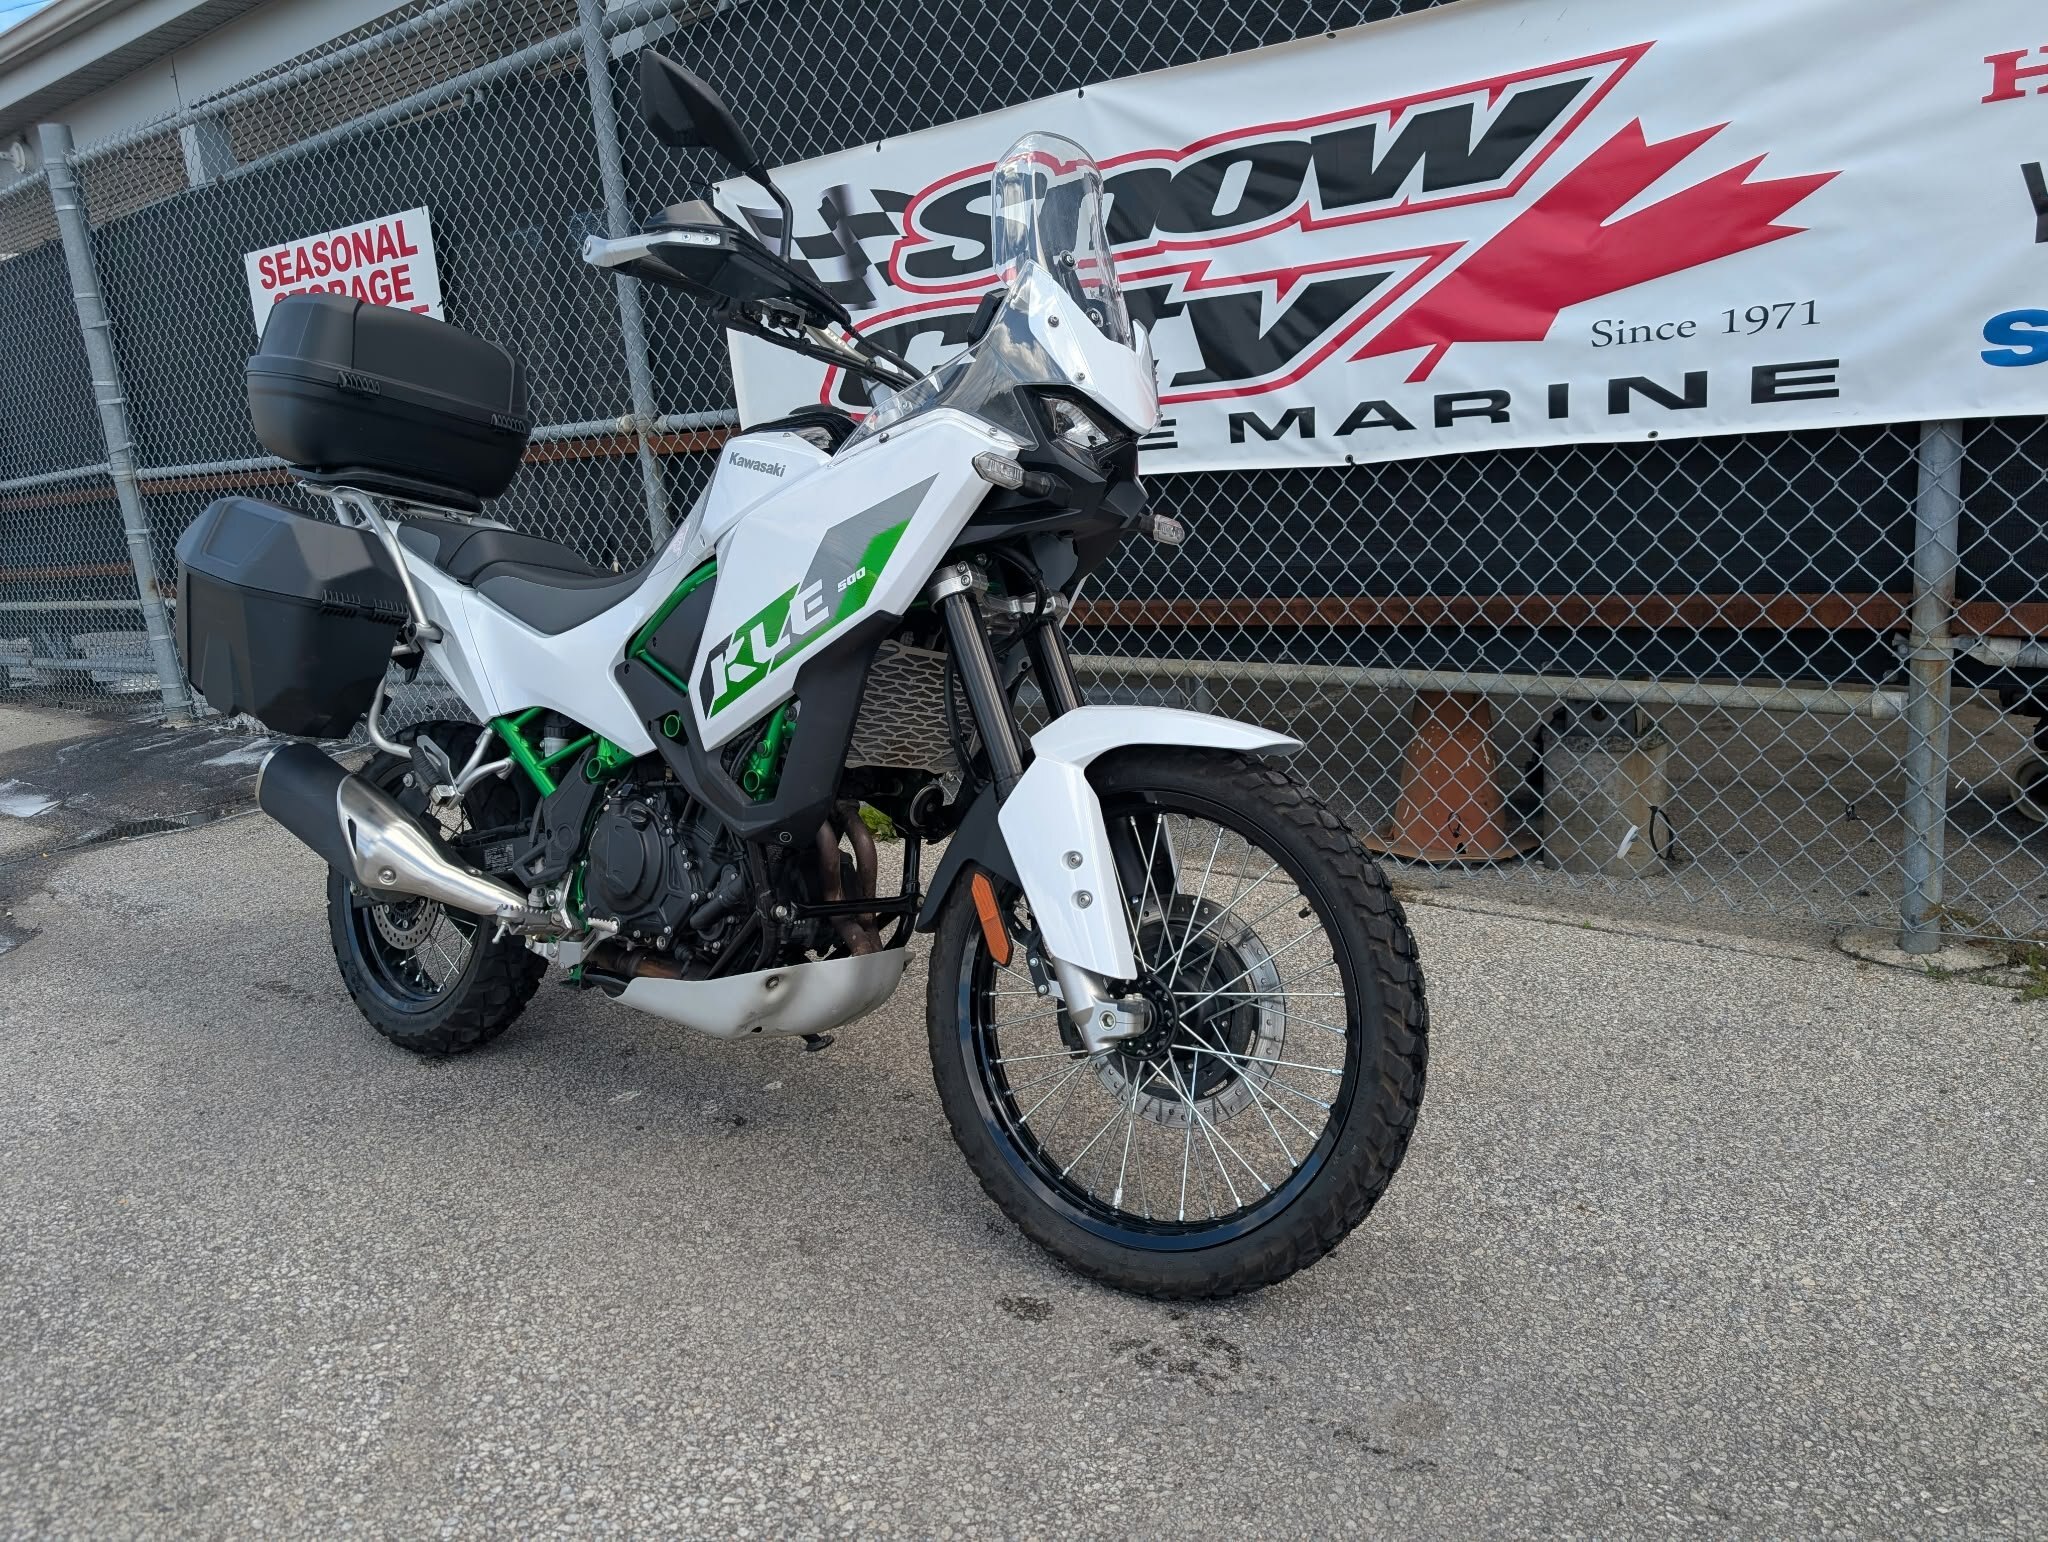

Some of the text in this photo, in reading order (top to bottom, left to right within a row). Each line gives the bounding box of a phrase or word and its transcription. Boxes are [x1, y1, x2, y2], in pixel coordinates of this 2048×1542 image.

[259, 220, 419, 289] SEASONAL
[1591, 300, 1821, 348] Since 1971
[1229, 359, 1840, 444] MARINE
[728, 452, 787, 478] Kawasaki
[711, 566, 866, 701] KLE 500
